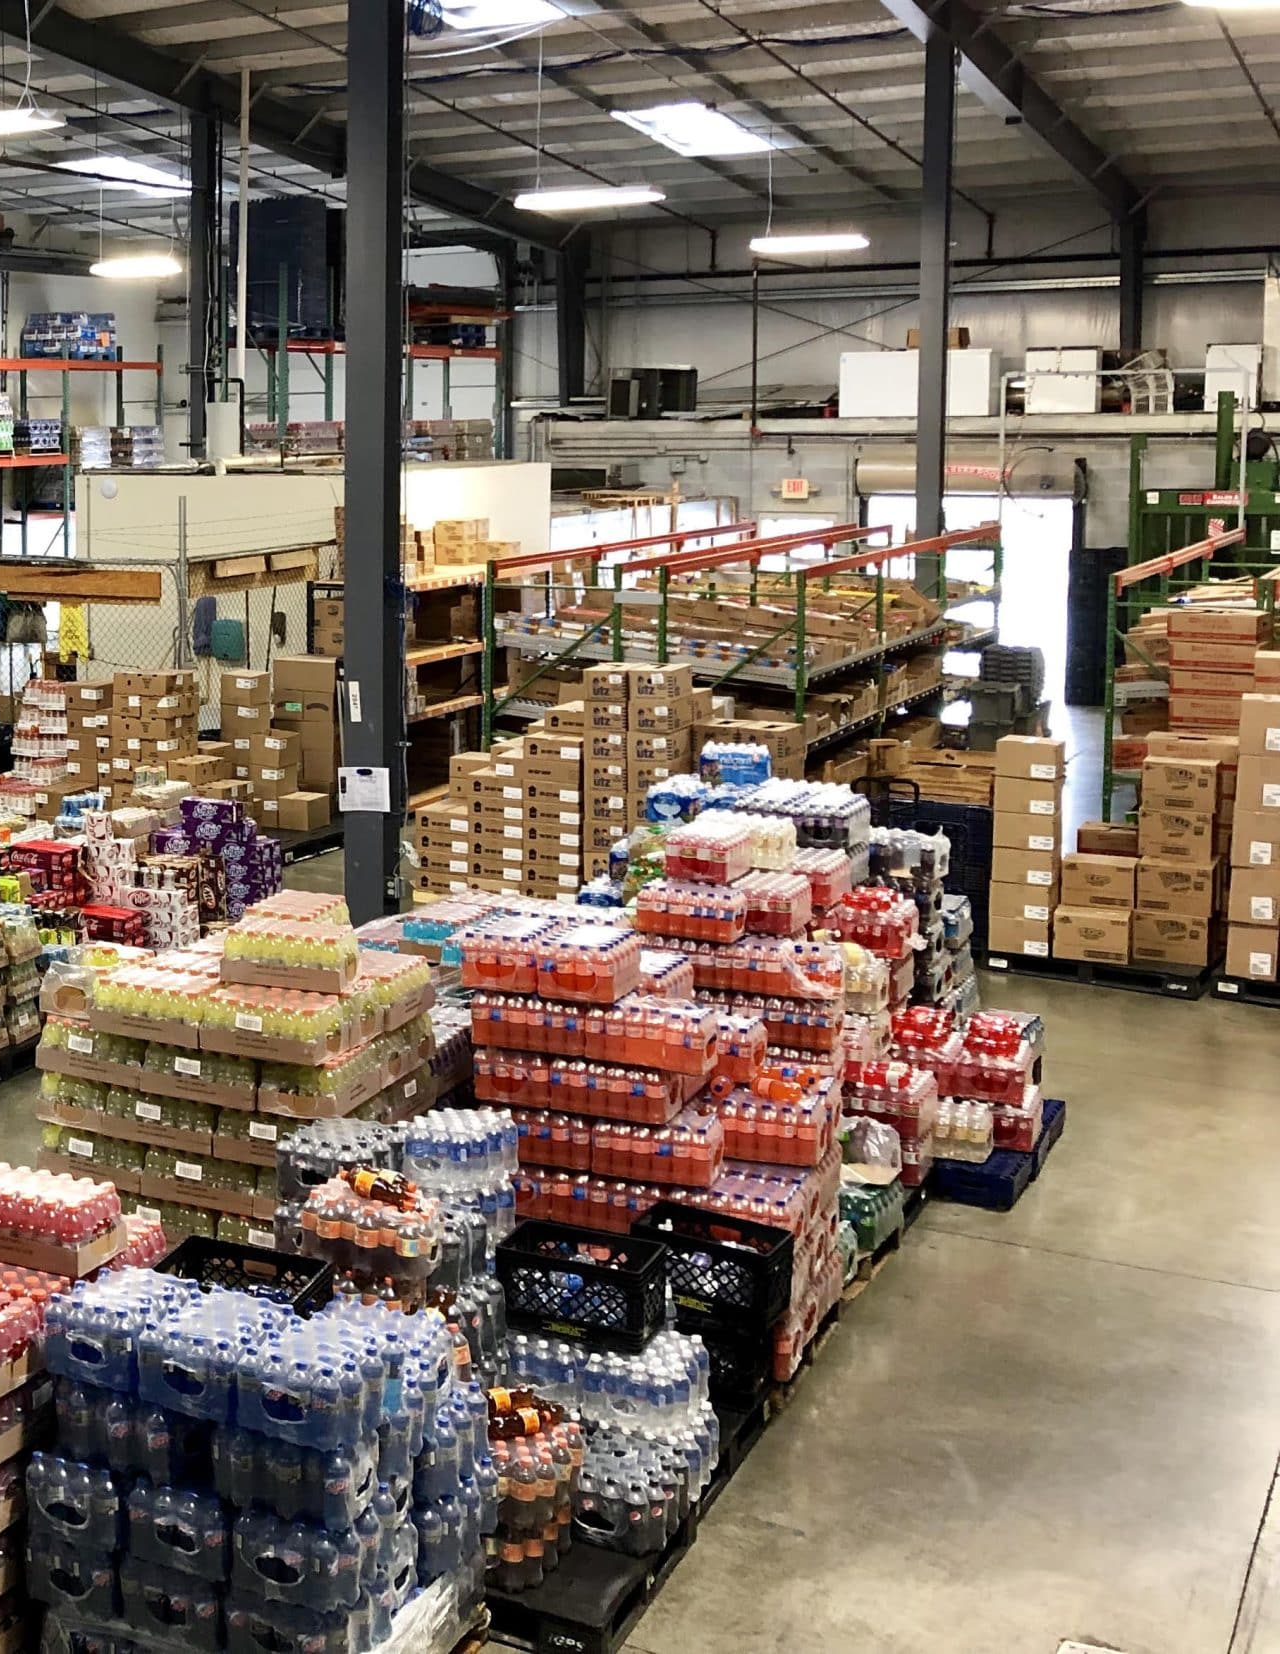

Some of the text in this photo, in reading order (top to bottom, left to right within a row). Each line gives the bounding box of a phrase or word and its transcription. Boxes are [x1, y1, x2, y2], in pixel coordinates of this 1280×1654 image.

[787, 479, 803, 493] EXIT
[593, 686, 609, 696] utz
[638, 685, 654, 695] utz
[593, 717, 610, 726] utz
[638, 718, 655, 728] utz
[593, 747, 610, 756] utz
[637, 749, 654, 759] utz
[594, 777, 610, 787] utz
[594, 807, 611, 817] utz
[593, 837, 610, 847] utz
